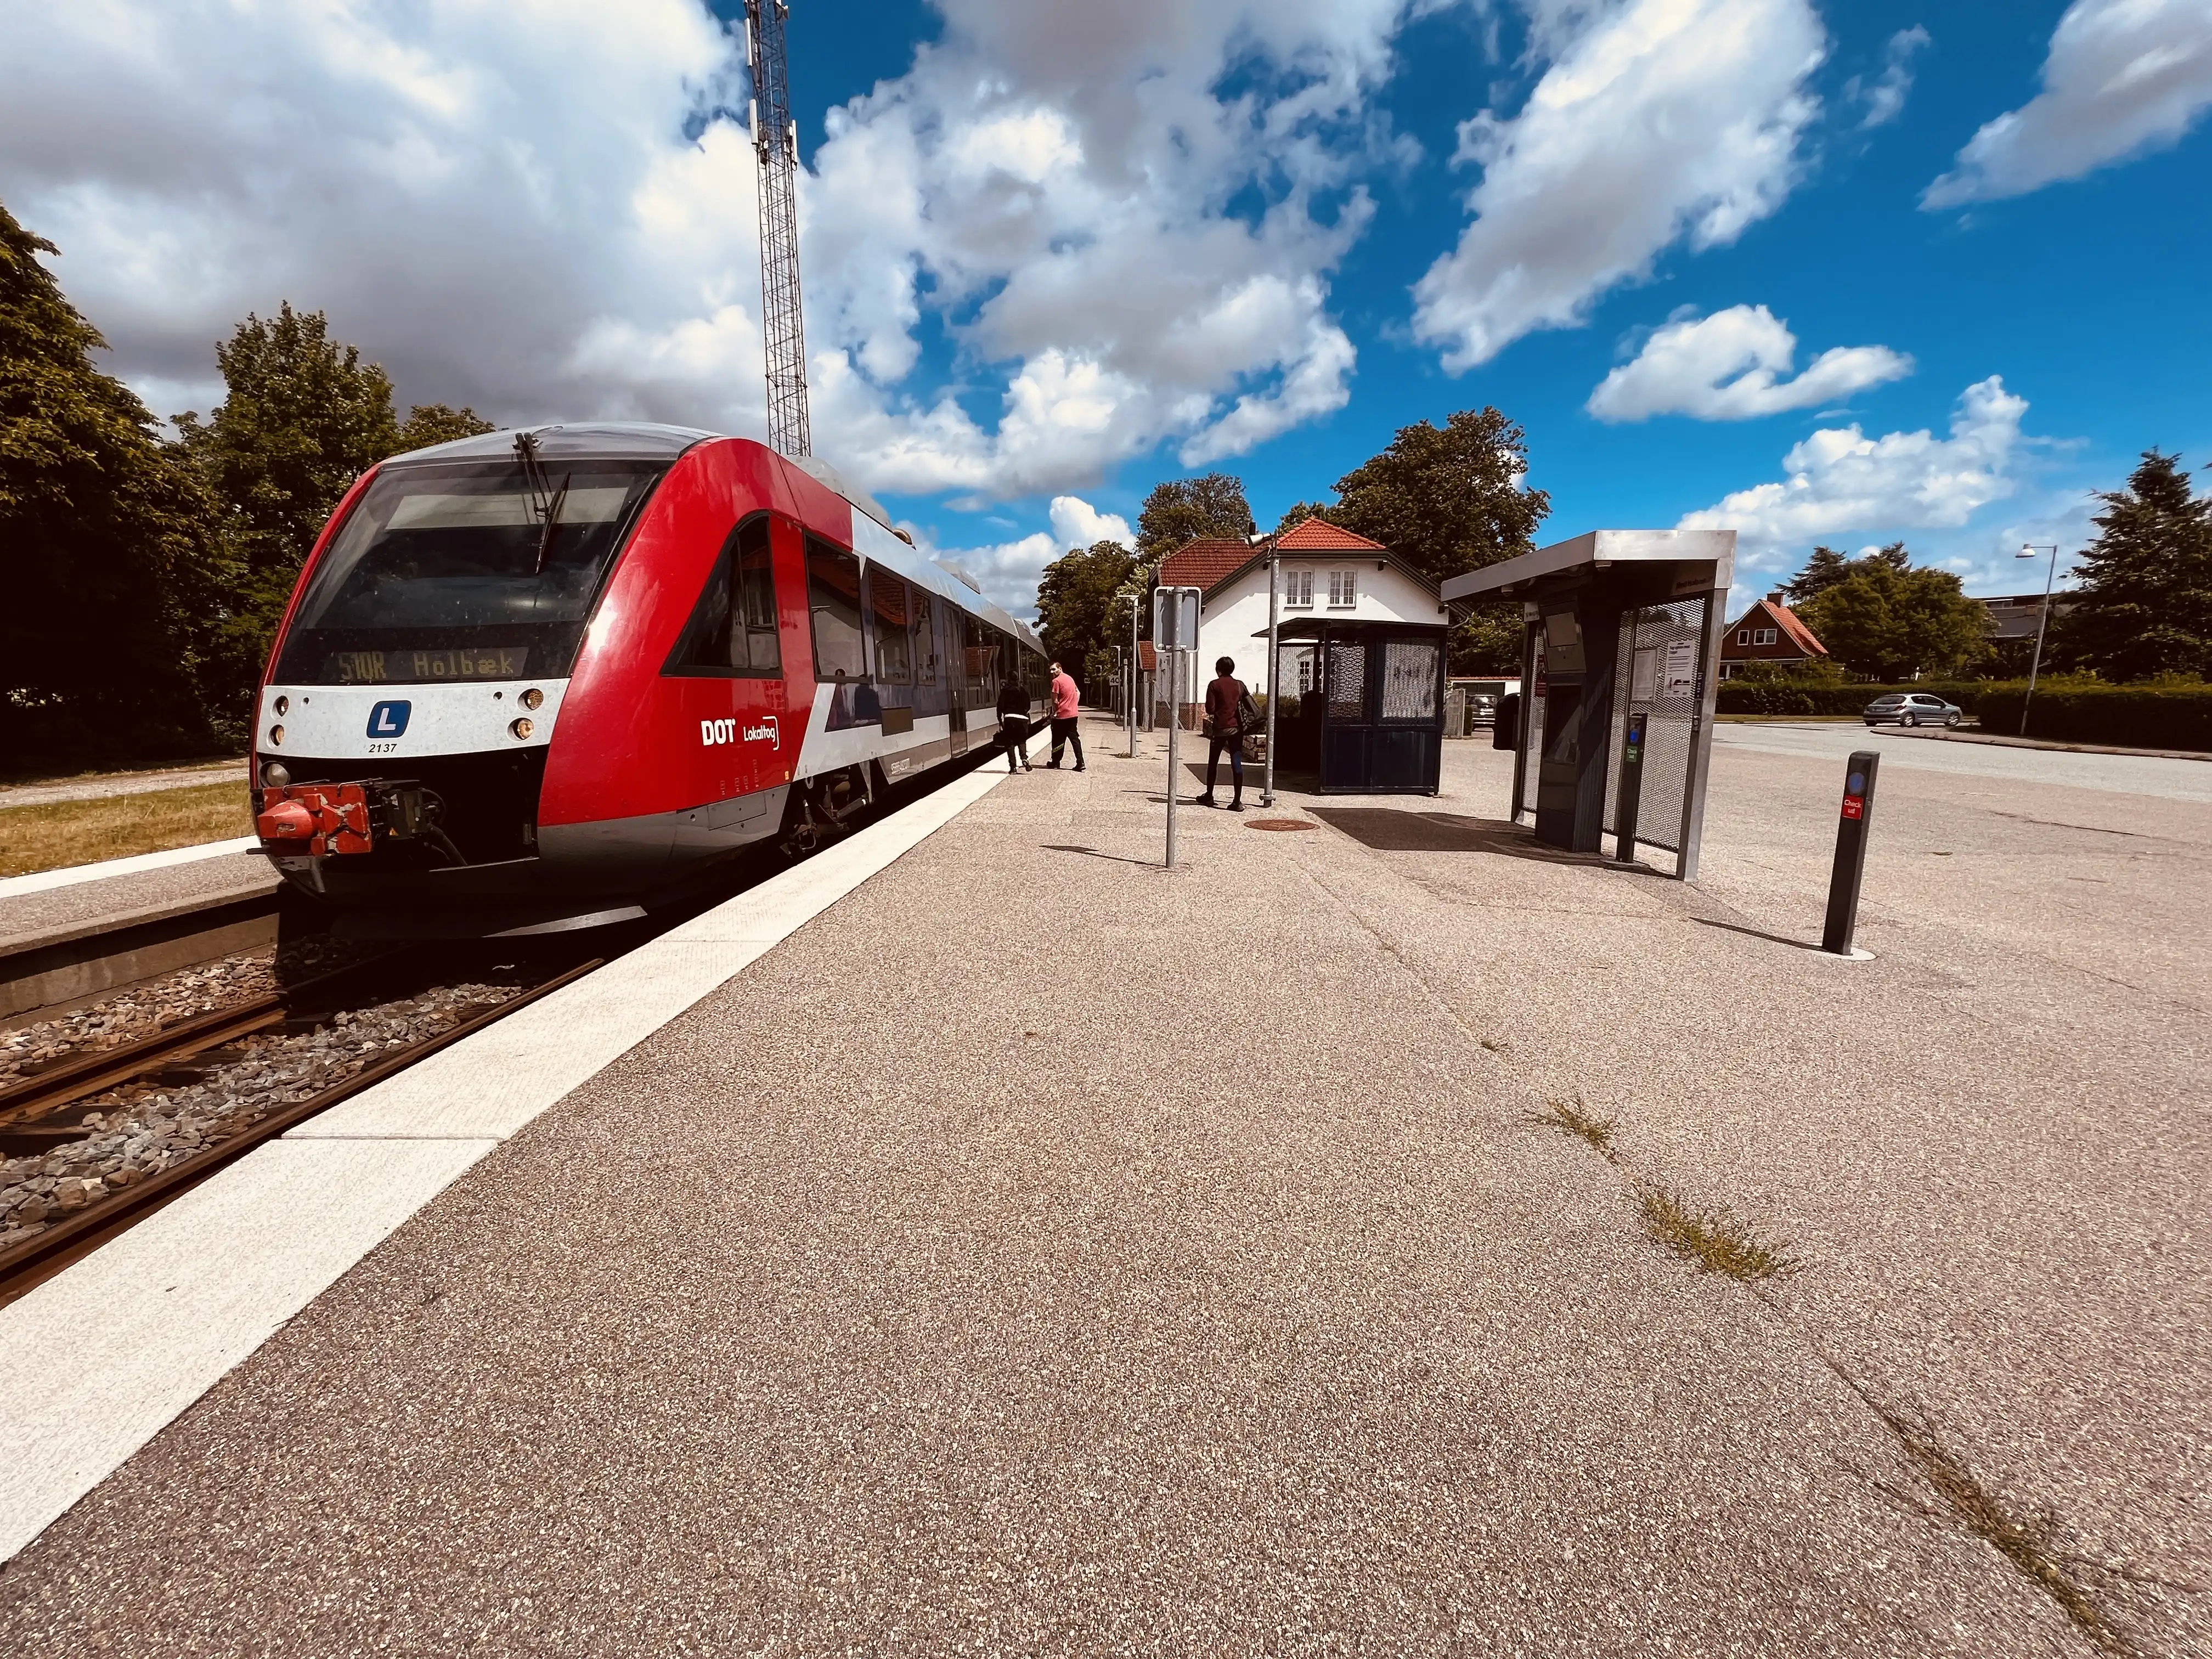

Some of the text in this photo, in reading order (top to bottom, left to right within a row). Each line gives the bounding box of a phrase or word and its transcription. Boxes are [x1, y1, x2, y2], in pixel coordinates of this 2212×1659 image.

[413, 650, 514, 676] Holbæk
[377, 707, 396, 731] L
[701, 718, 775, 746] DOT Lokaltog
[368, 743, 397, 753] 2137
[1844, 799, 1861, 808] Check
